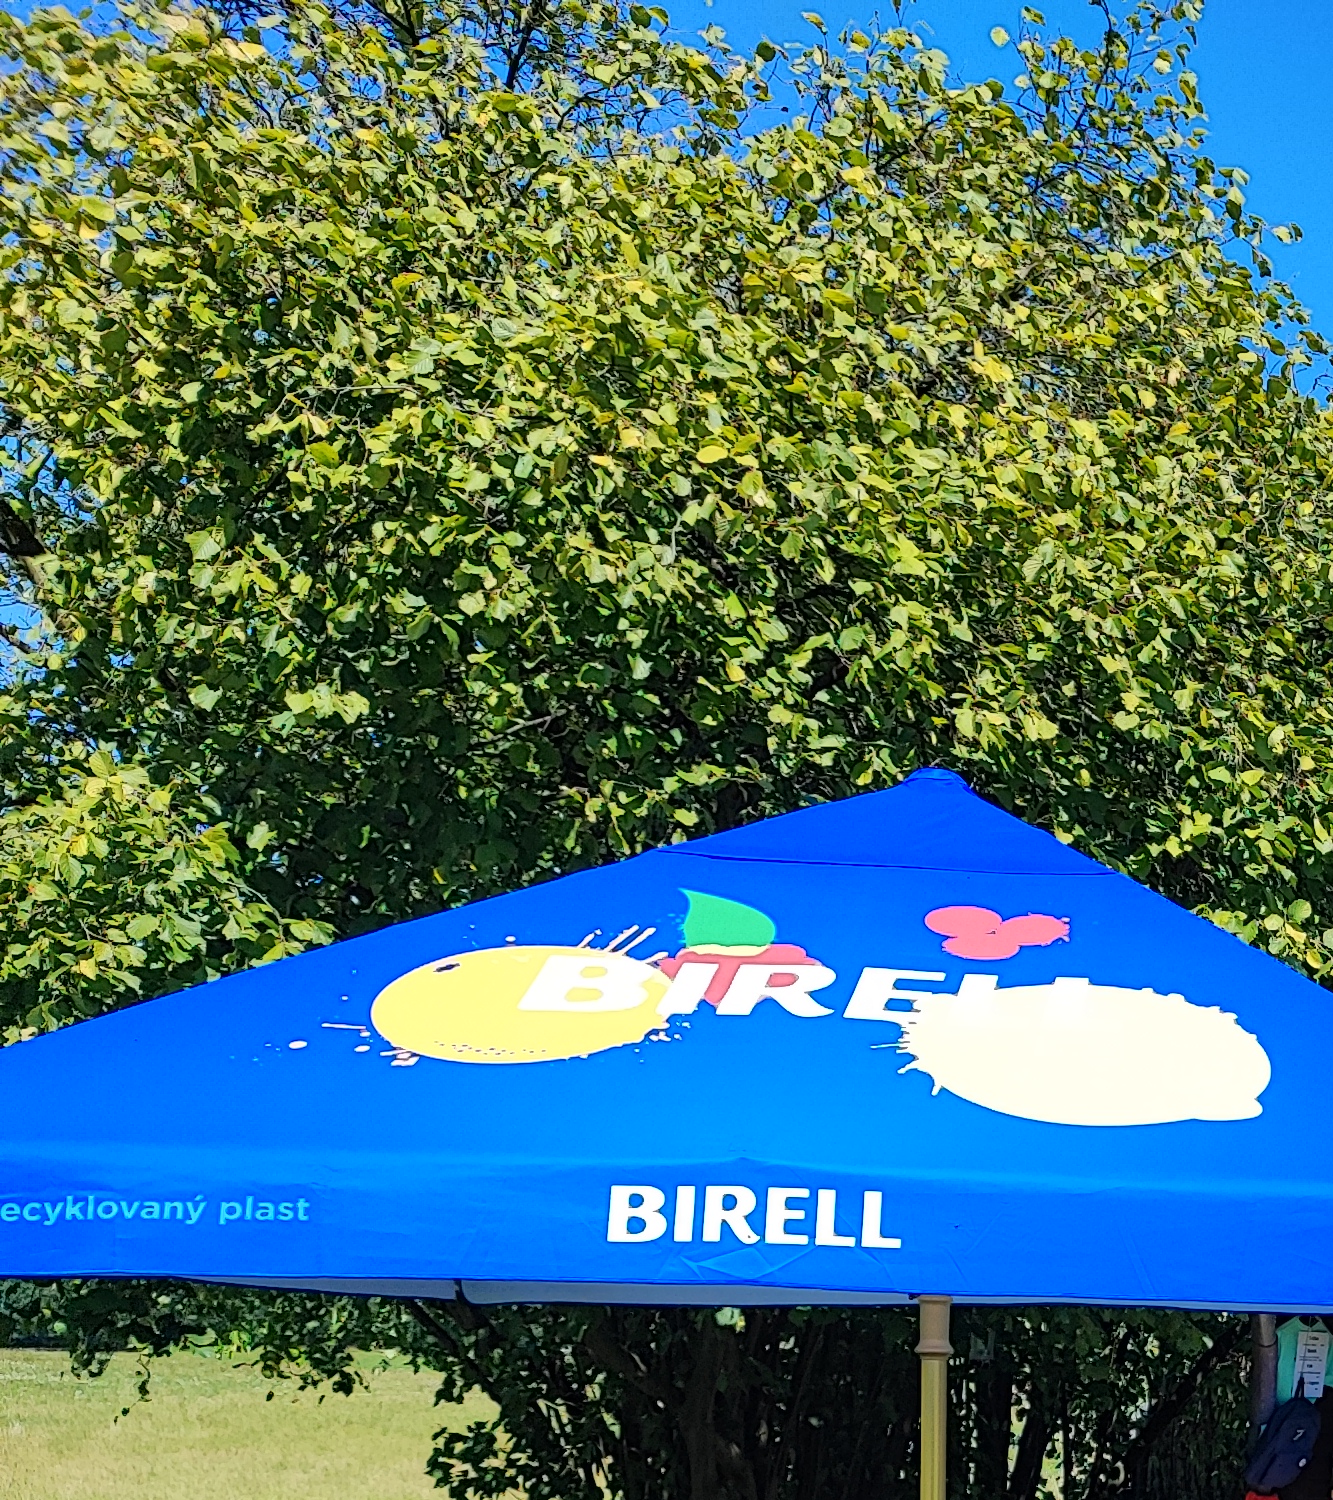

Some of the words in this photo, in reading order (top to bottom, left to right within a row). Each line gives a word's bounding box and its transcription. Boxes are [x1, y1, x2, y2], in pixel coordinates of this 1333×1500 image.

[517, 954, 1094, 1022] BIRE
[0, 1195, 203, 1226] ecyklovaný
[219, 1195, 309, 1225] plast
[606, 1184, 902, 1250] BIRELL
